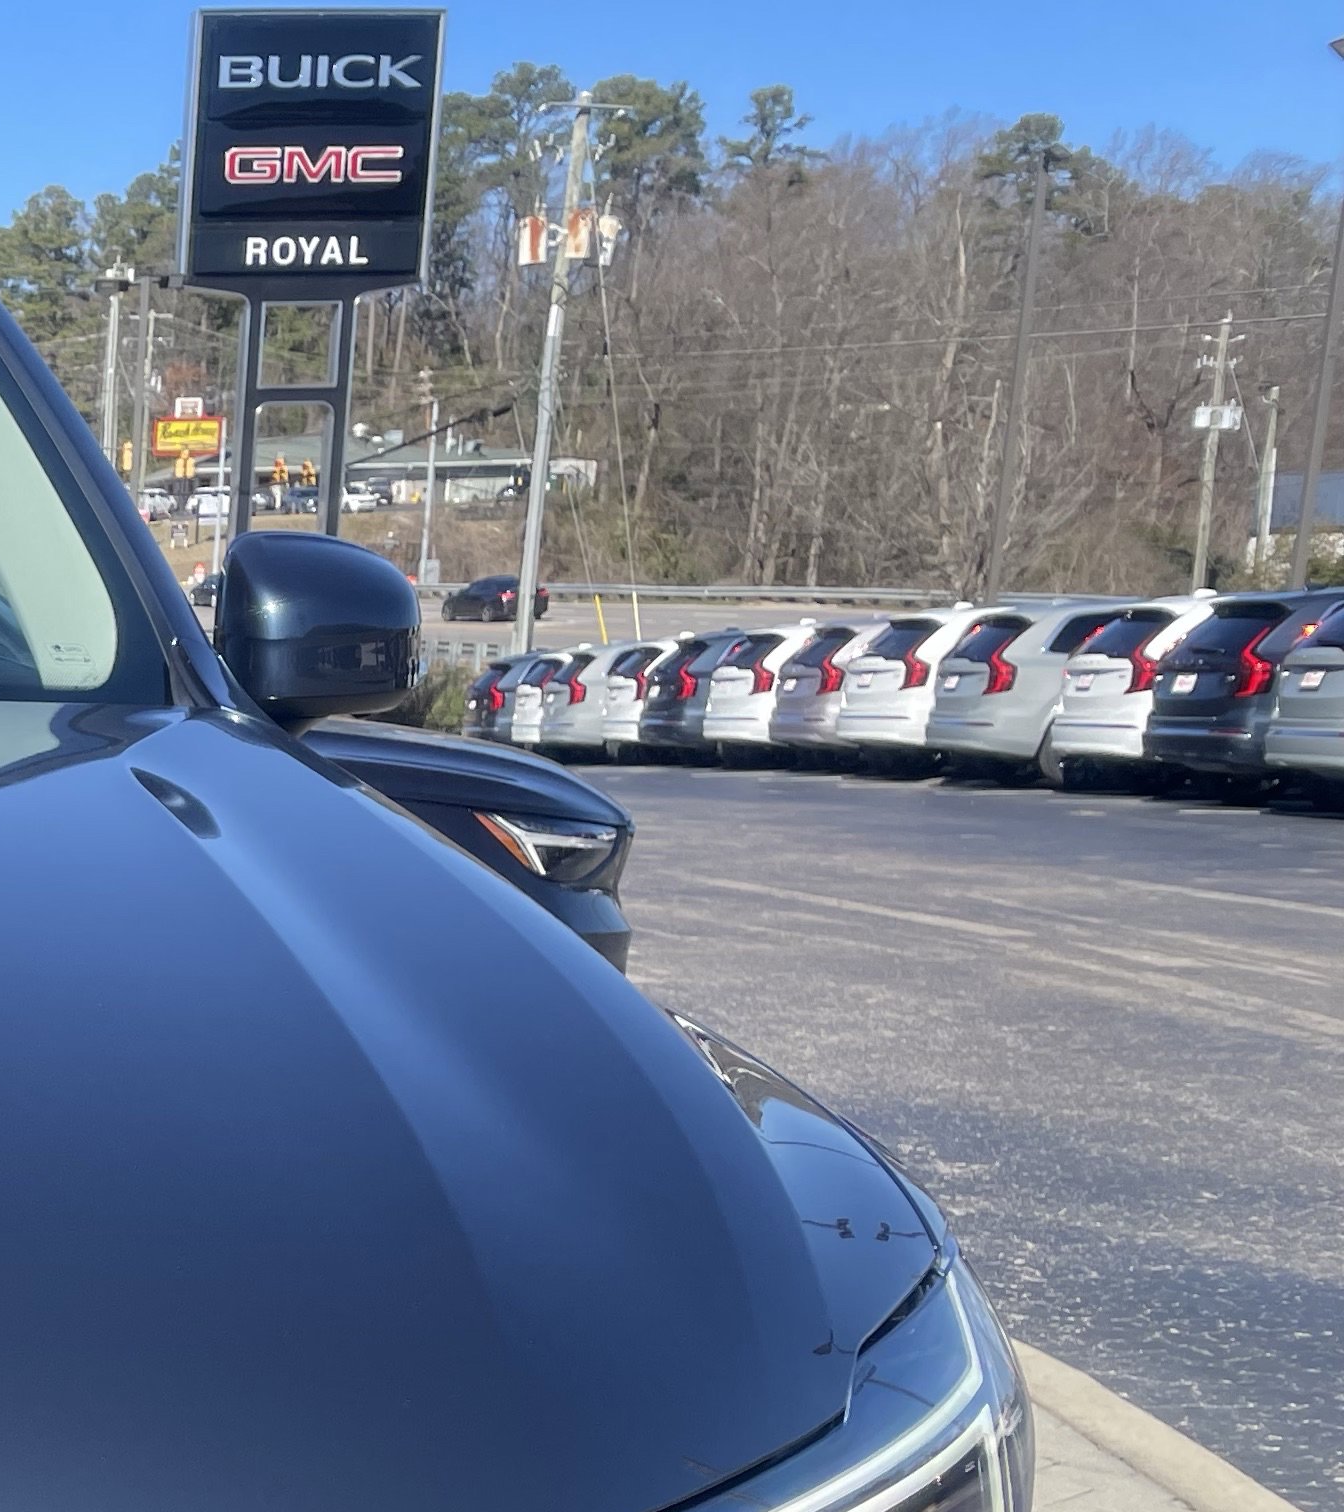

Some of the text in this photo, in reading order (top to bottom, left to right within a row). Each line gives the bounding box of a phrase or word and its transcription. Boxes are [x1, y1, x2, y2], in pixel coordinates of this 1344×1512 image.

[218, 54, 423, 89] BUICK
[224, 146, 404, 184] GMC
[245, 235, 369, 266] ROYAL
